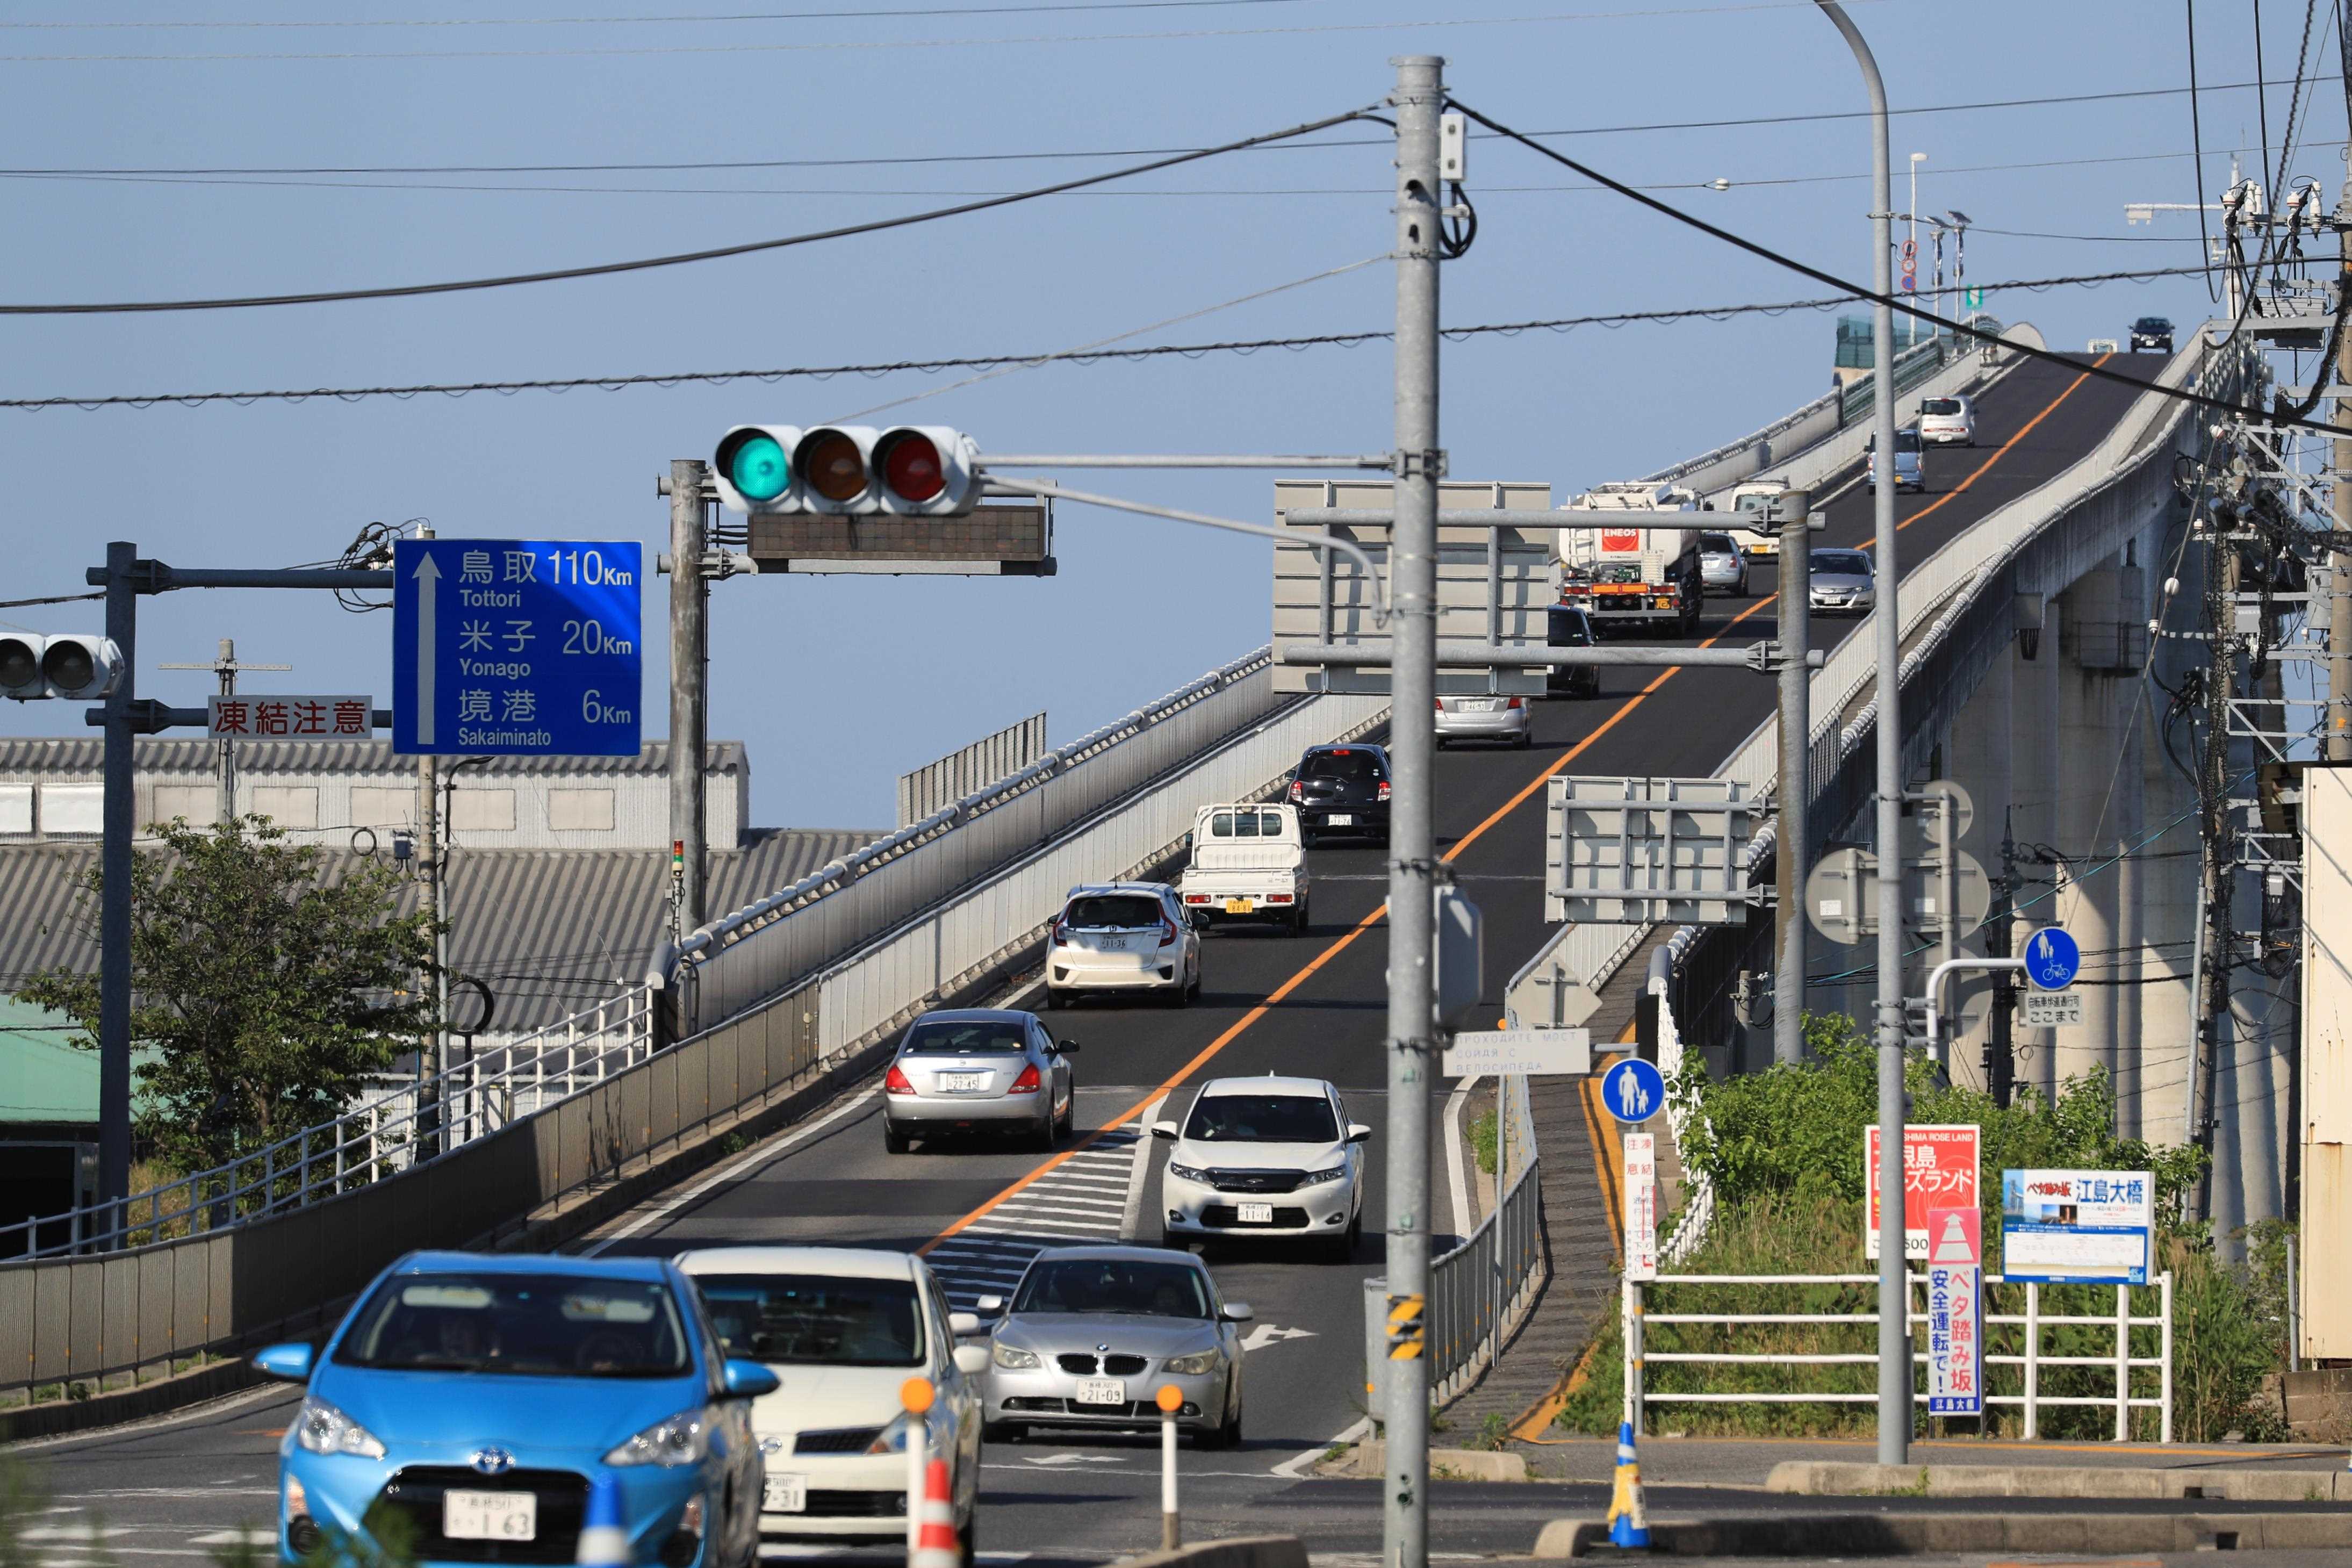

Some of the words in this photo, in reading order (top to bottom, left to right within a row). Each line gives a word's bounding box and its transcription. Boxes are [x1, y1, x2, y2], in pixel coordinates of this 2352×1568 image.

[1604, 528, 1636, 537] ENEOS
[459, 550, 537, 584] 鳥取
[459, 589, 521, 607] Tottori
[459, 619, 536, 652] 米子
[459, 658, 531, 680] Yonago
[458, 688, 536, 722] 境港
[214, 700, 366, 735] 凍結注意
[458, 728, 551, 746] Sakaiminato
[2030, 1010, 2080, 1023] ここまで
[1456, 1032, 1533, 1045] ПРОХОДИТЕ
[1543, 1031, 1577, 1042] МОСТ
[1456, 1062, 1542, 1073] ВЕЛОСИПЕДА
[953, 1080, 977, 1089] 27-45
[1929, 1133, 1950, 1142] ROSE
[1952, 1133, 1974, 1142] LAND
[2076, 1178, 2144, 1205] 江島大橋
[1931, 1269, 1950, 1393] 安全運転で!
[1951, 1270, 1972, 1392] ベタ踏み坂
[1087, 1390, 1120, 1402] 21-09
